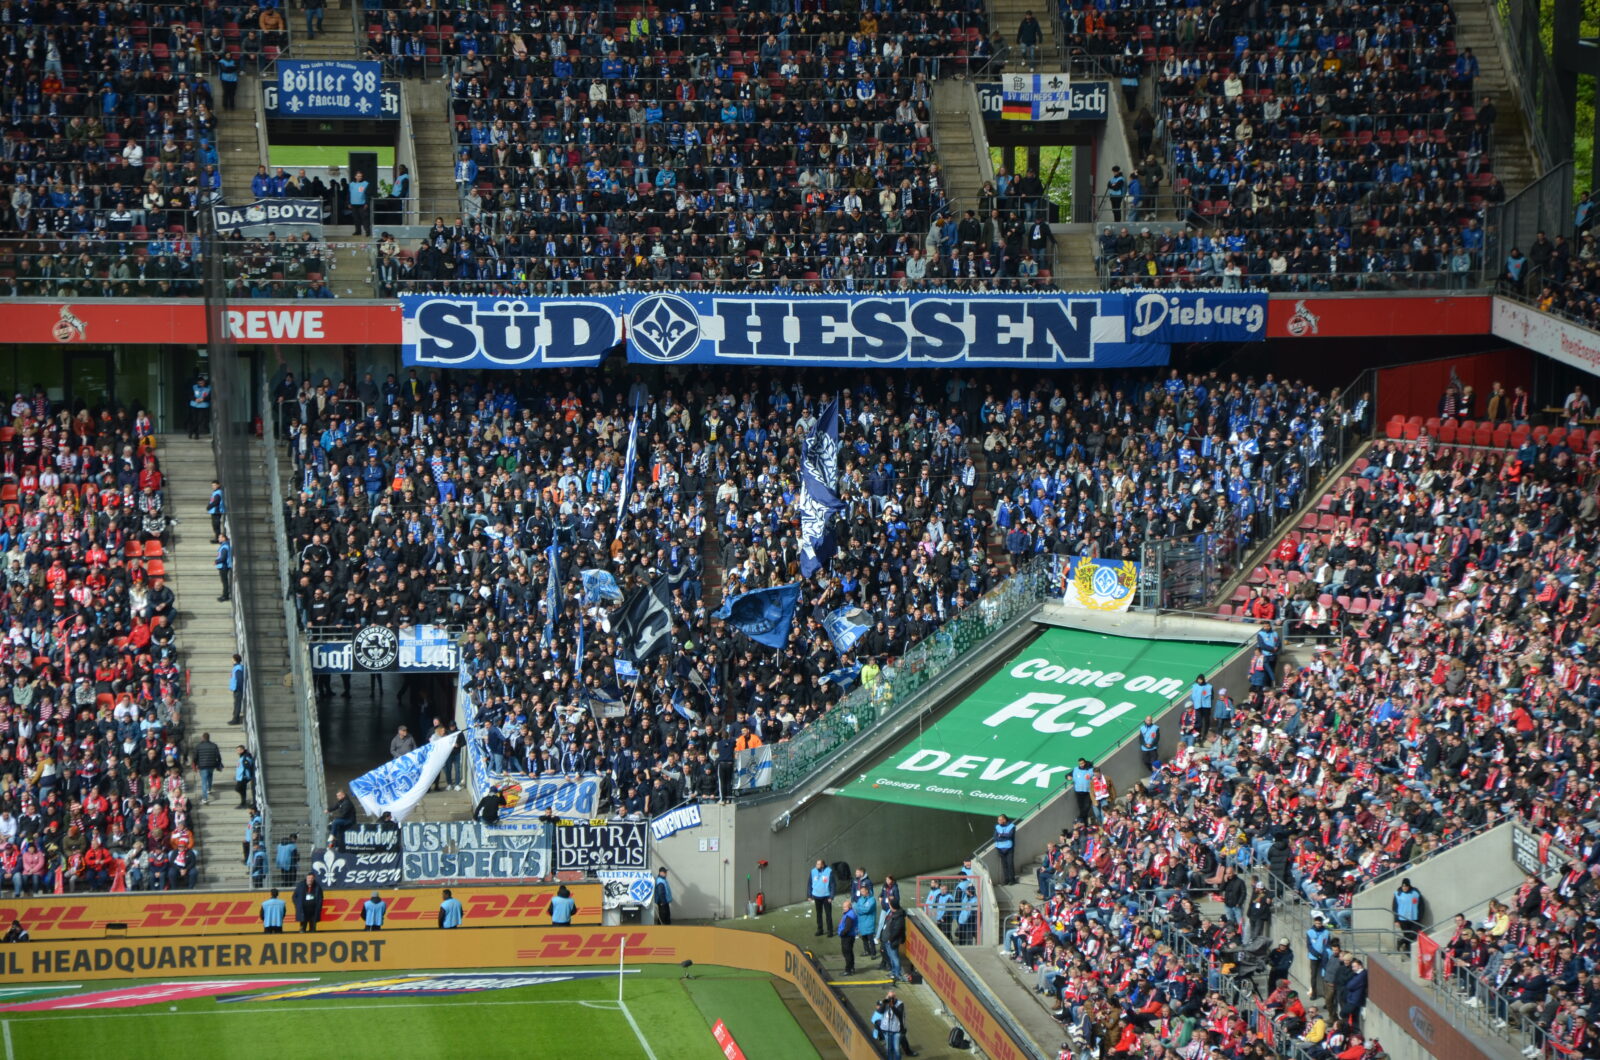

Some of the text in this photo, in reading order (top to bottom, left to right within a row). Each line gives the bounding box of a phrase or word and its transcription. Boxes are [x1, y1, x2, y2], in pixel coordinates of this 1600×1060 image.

[282, 69, 377, 93] Böller 98
[308, 93, 351, 107] FANCLUB
[217, 204, 319, 225] DA BOYZ
[221, 310, 325, 339] REWE
[1132, 293, 1264, 337] Dieburg
[416, 298, 1101, 364] SÜD HESSEN
[357, 627, 394, 642] DARMSTADT
[374, 651, 395, 667] SPORT
[1010, 658, 1184, 700] Come on,
[982, 692, 1137, 738] FC!
[896, 749, 1072, 789] DEVK
[524, 781, 597, 814] 1898
[875, 778, 1029, 804] Gesagt. Getan. Geholfen.
[344, 824, 398, 850] underdogs
[403, 823, 497, 852] USUAL
[559, 825, 643, 848] ULTRA
[356, 852, 397, 866] ROW
[405, 851, 541, 879] SUSPECTS
[561, 848, 644, 866] DE LIS
[344, 868, 401, 883] SEVEN
[139, 901, 263, 928] DHL
[32, 943, 252, 974] HEADQUARTER
[259, 939, 386, 965] AIRPORT
[539, 933, 652, 958] DHL
